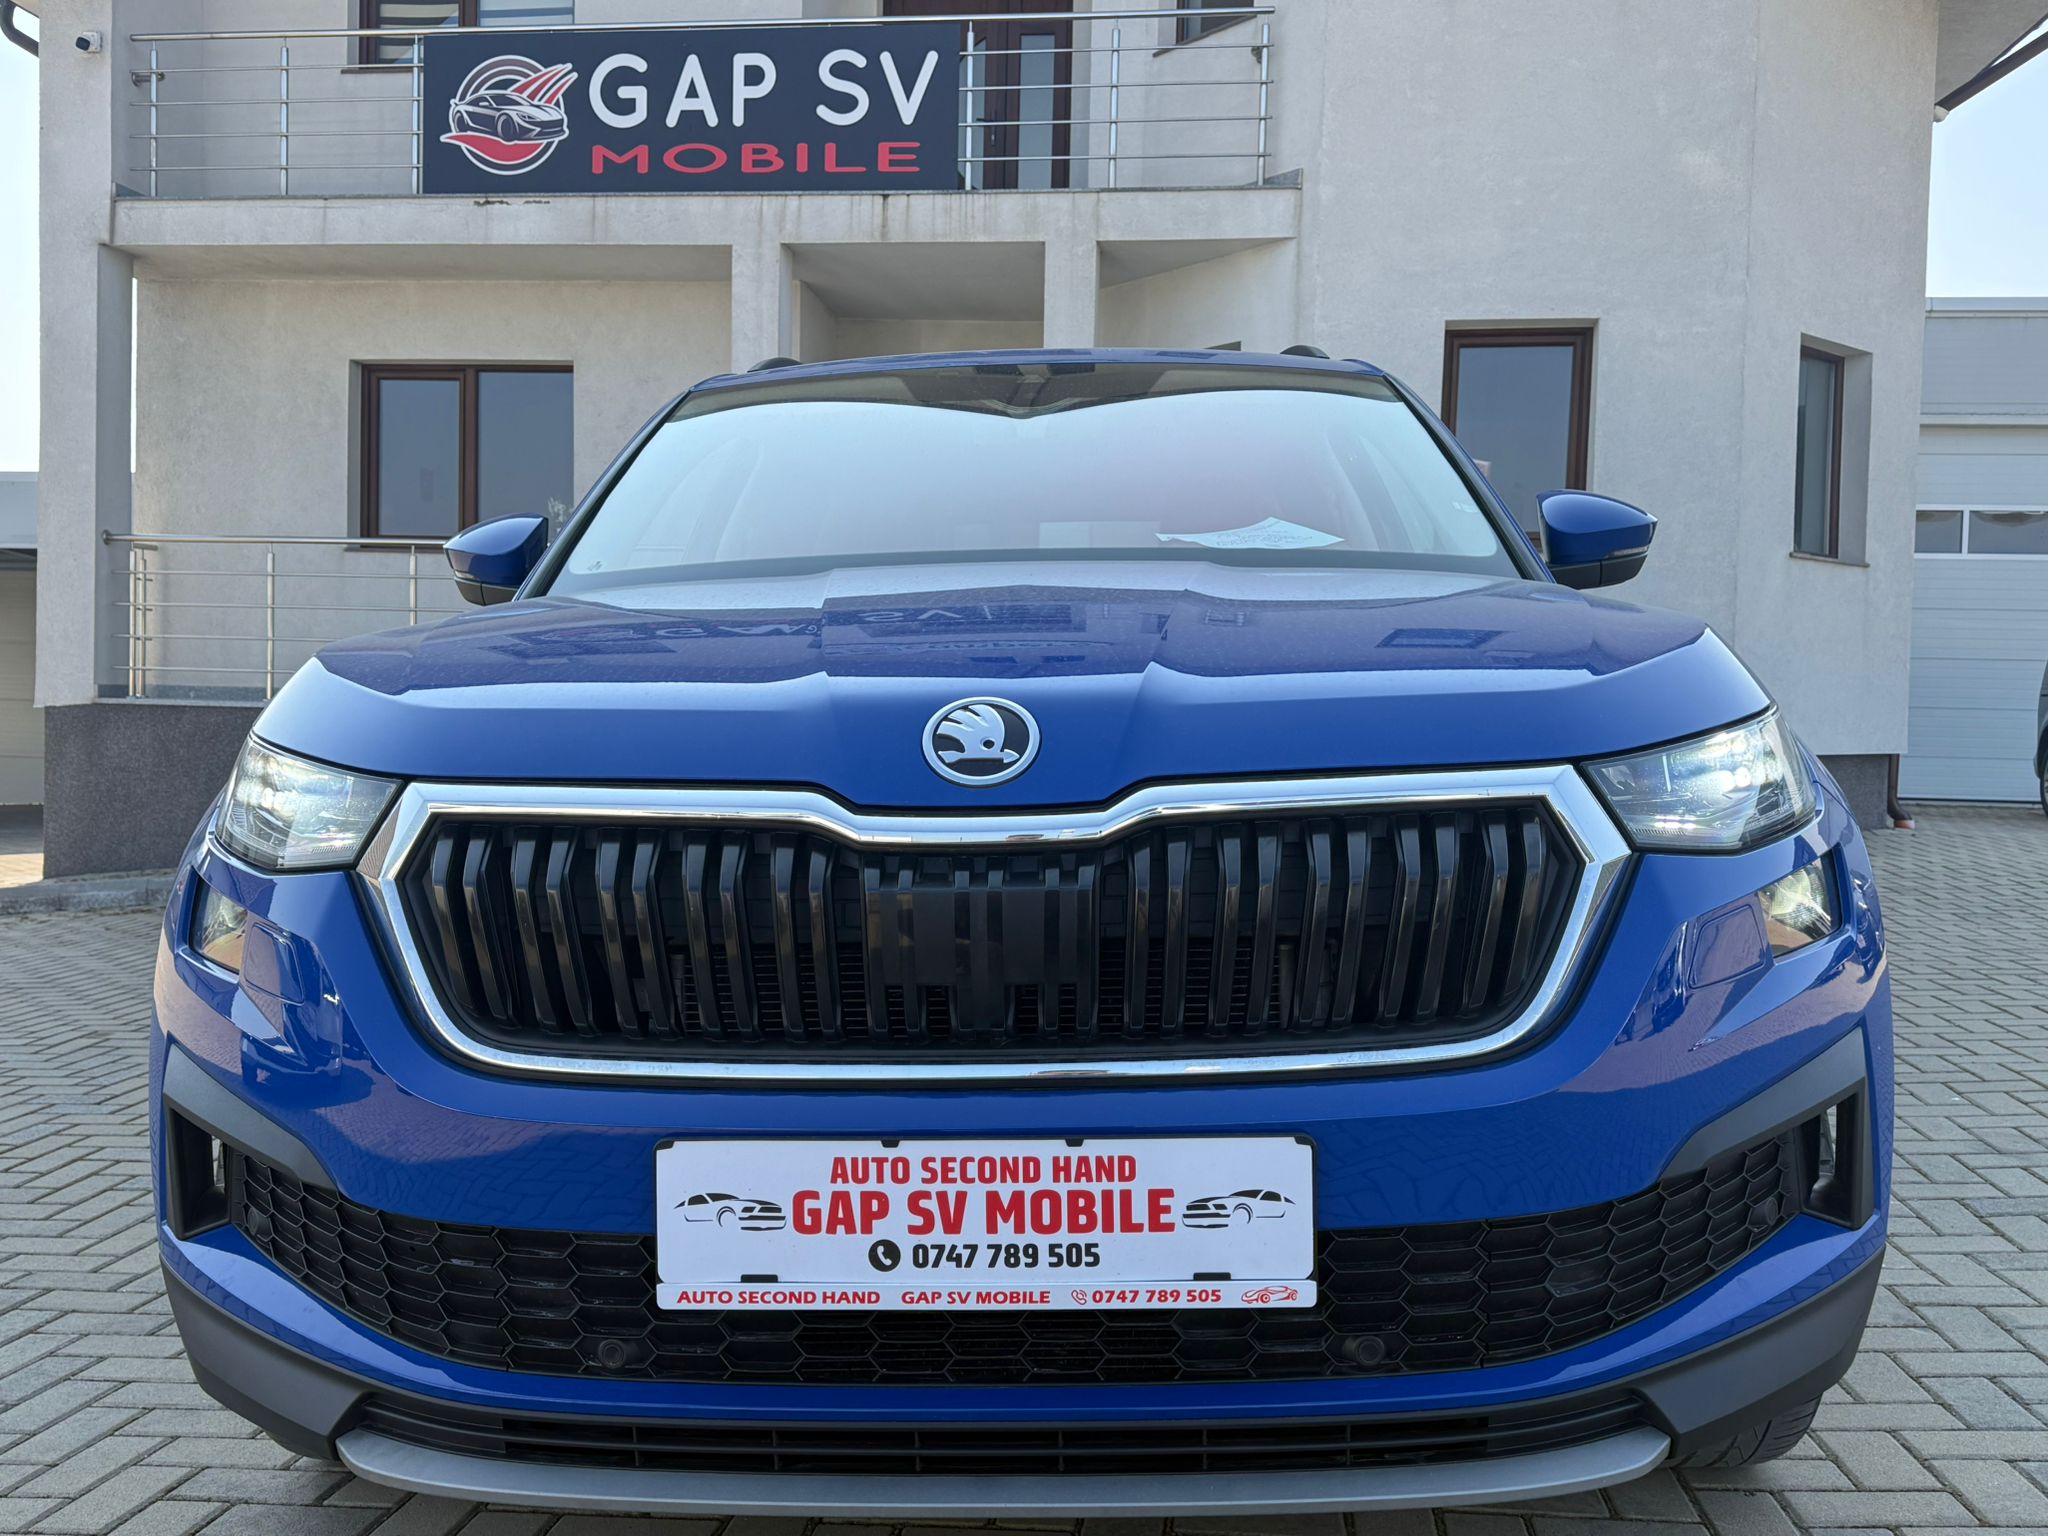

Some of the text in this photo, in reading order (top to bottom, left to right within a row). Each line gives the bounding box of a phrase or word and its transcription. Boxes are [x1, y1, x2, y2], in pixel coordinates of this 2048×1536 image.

[588, 48, 939, 129] GAP SV
[591, 141, 921, 175] MOBILE
[829, 1154, 1137, 1185] AUTO SECOND HAND
[792, 1188, 1176, 1236] GAP SV MOBILE
[912, 1242, 1101, 1269] 0747 789 505
[676, 1290, 881, 1305] AUTO SECOND HAND
[901, 1290, 1051, 1305] GAP SV MOBILE
[1091, 1288, 1222, 1304] 0747 789 505
